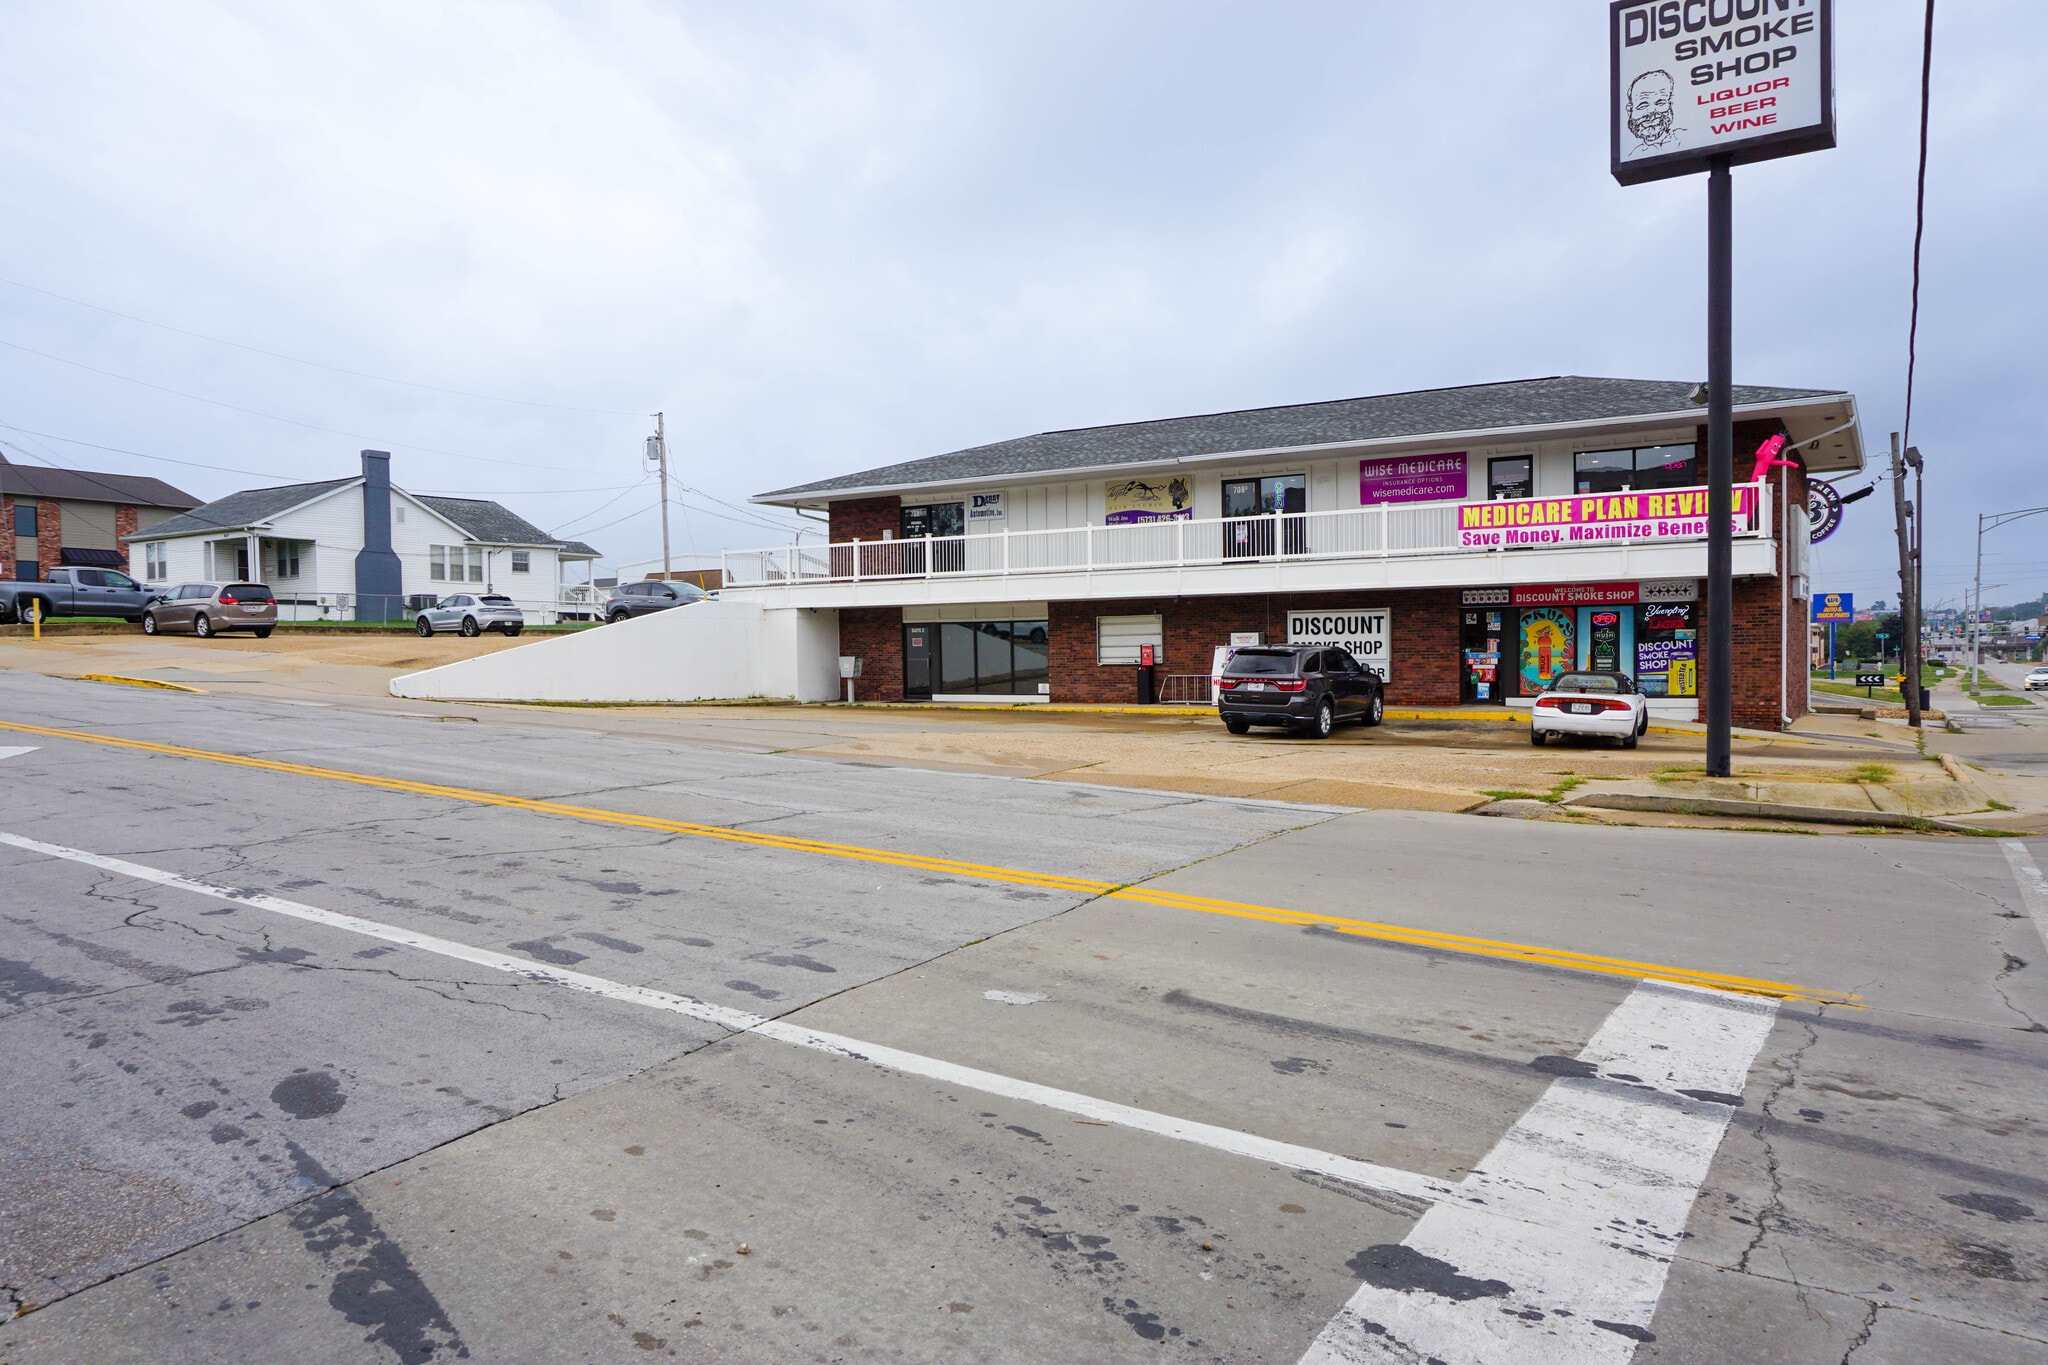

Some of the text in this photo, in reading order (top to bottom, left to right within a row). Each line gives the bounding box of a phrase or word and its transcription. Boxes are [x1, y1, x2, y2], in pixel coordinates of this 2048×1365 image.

[1625, 0, 1806, 47] DISCOU
[1675, 11, 1813, 61] SMOKE
[1691, 46, 1796, 86] SHOP
[1697, 77, 1790, 105] LIQUOR
[1710, 97, 1776, 119] BEER
[1711, 113, 1777, 135] WINE
[1365, 458, 1461, 477] WISE MEDICARE
[1664, 461, 1687, 471] open
[1372, 485, 1455, 498] wisemedicare.com
[1463, 501, 1572, 528] MEDICARE
[1582, 494, 1638, 521] PLAN
[1462, 516, 1742, 546] Save Money. Maximize Benefs.
[1811, 518, 1837, 540] COFFEE
[1516, 593, 1565, 603] DISCOUNT
[1567, 591, 1604, 601] SMOKE
[1606, 590, 1635, 600] SHOP
[1554, 587, 1585, 595] WELCOME
[1592, 614, 1617, 623] OPEN
[1645, 604, 1690, 617] Yuengling
[1292, 616, 1384, 636] DISCOUNT
[1520, 608, 1575, 639] TRULY
[1649, 617, 1686, 629] LAGER
[1344, 640, 1382, 655] SHOP
[1638, 640, 1694, 652] DISCOUNT
[1639, 651, 1669, 660] SMOKE
[1639, 660, 1667, 670] SHOP
[1678, 663, 1687, 694] TWISTED TEA
